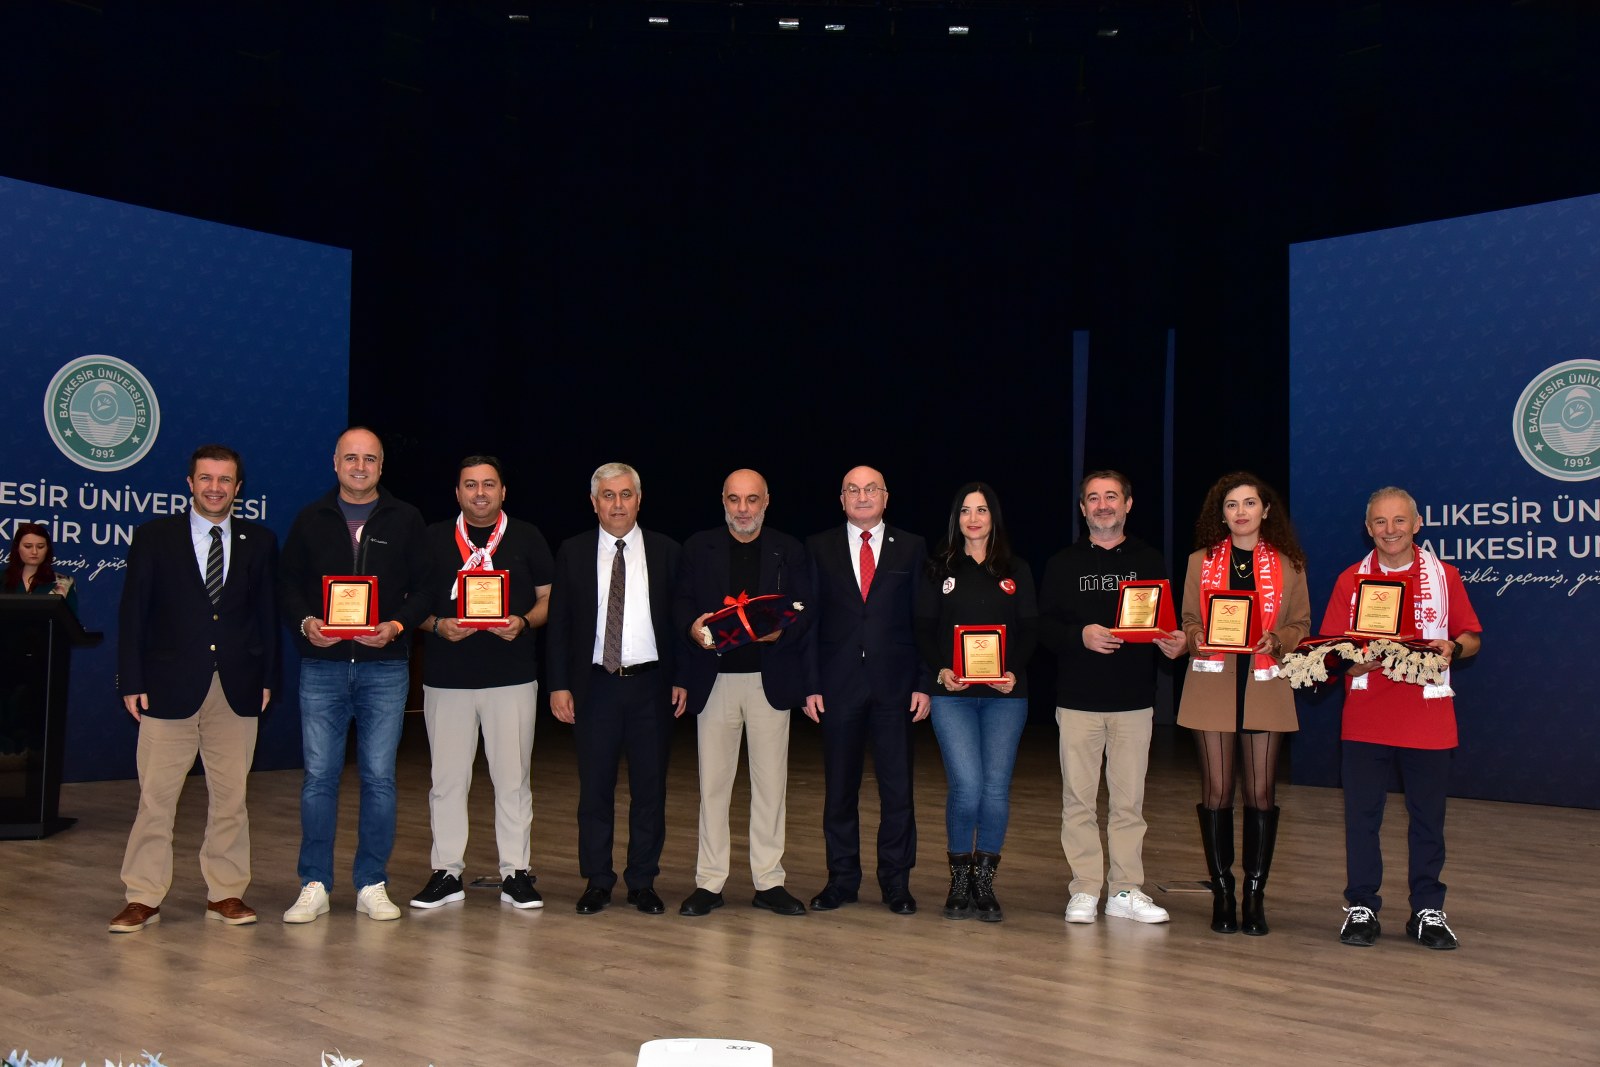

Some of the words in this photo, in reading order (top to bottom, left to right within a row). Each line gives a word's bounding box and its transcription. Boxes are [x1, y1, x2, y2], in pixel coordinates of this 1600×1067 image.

[59, 370, 95, 418] BALIKESİR
[97, 368, 147, 428] ÜNİVERSİTESİ
[1528, 378, 1566, 433] BALIKESİR
[90, 448, 115, 458] 1992
[1564, 457, 1592, 467] 1992
[79, 482, 267, 521] ÜNİVERESİ
[1420, 496, 1542, 527] LIKESİR
[91, 522, 134, 546] UN
[1421, 530, 1557, 560] ALIKESİR
[1568, 535, 1600, 558] U
